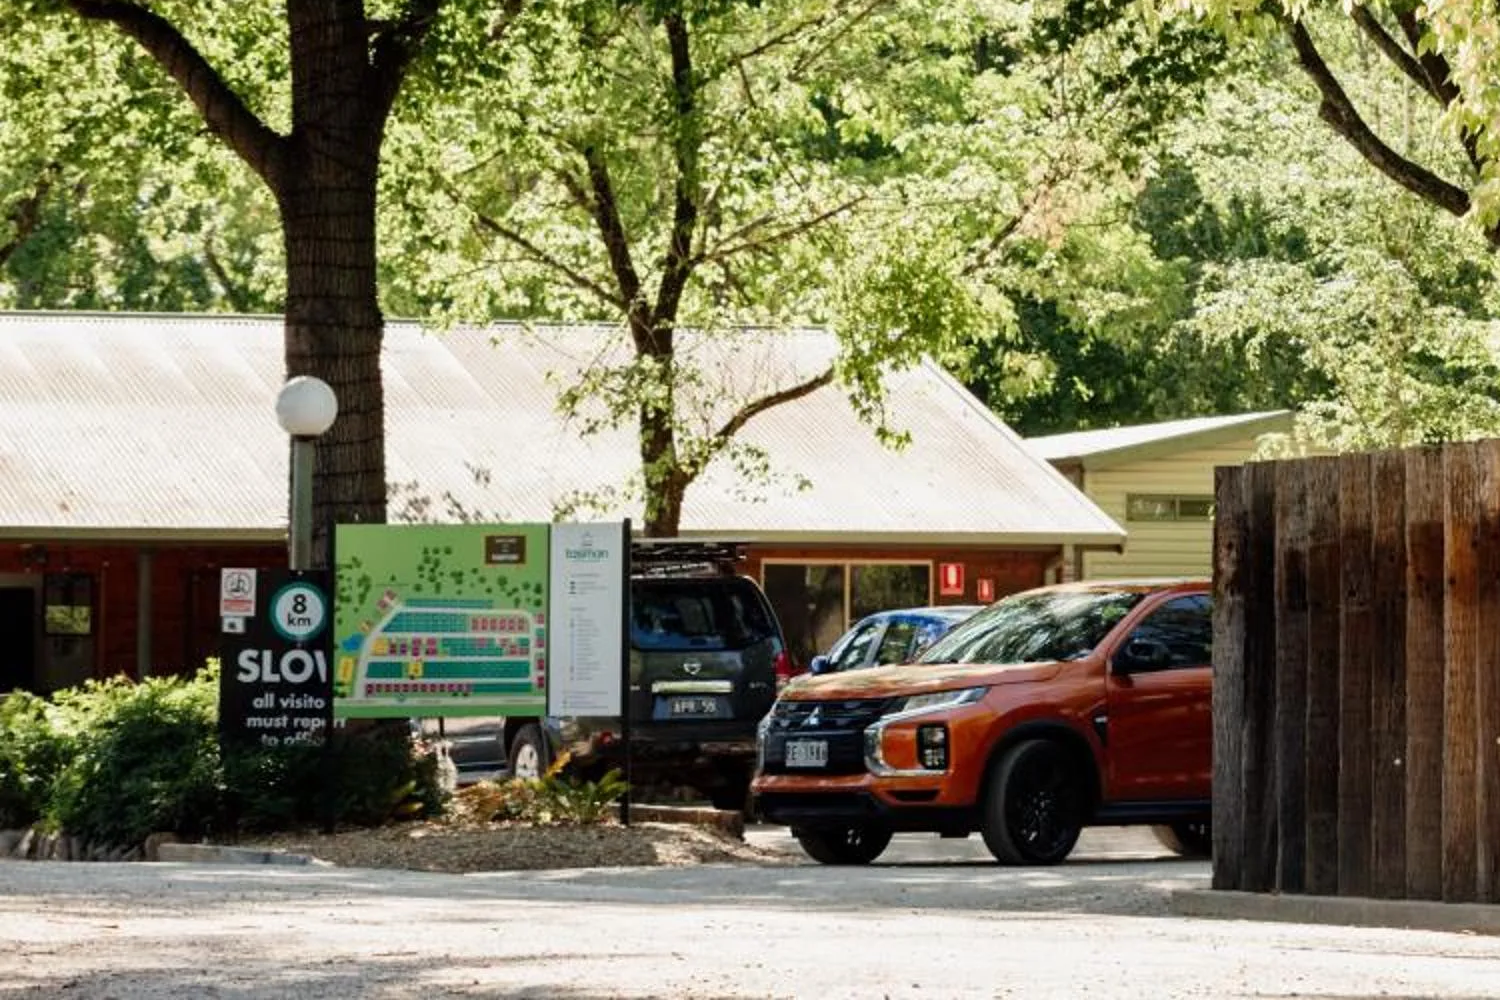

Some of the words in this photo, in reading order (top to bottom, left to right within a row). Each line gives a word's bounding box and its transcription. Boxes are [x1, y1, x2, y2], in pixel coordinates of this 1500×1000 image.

[292, 593, 307, 614] 8
[287, 612, 311, 626] km
[252, 692, 275, 709] all
[280, 692, 326, 709] visito
[246, 714, 288, 728] must
